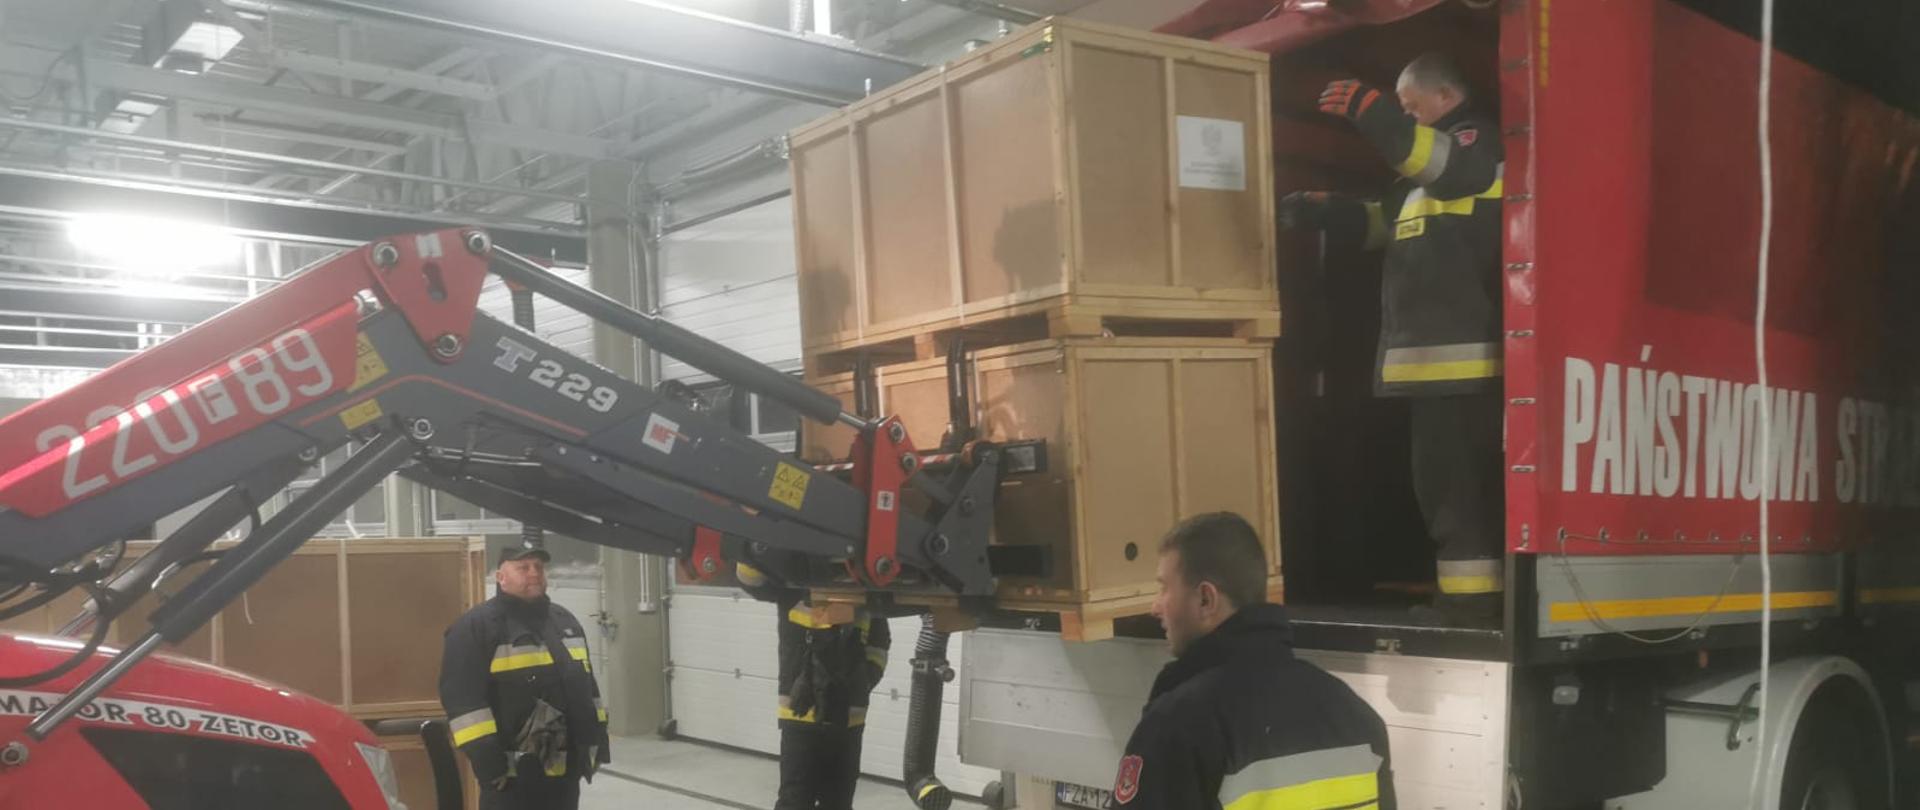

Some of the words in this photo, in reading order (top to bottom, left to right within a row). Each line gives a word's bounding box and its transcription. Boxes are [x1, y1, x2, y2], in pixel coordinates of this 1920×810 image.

[1562, 345, 1819, 502] PAŃSTWOWA
[0, 694, 126, 722] MAOR
[144, 706, 186, 728] 80
[200, 714, 304, 747] ZETOR
